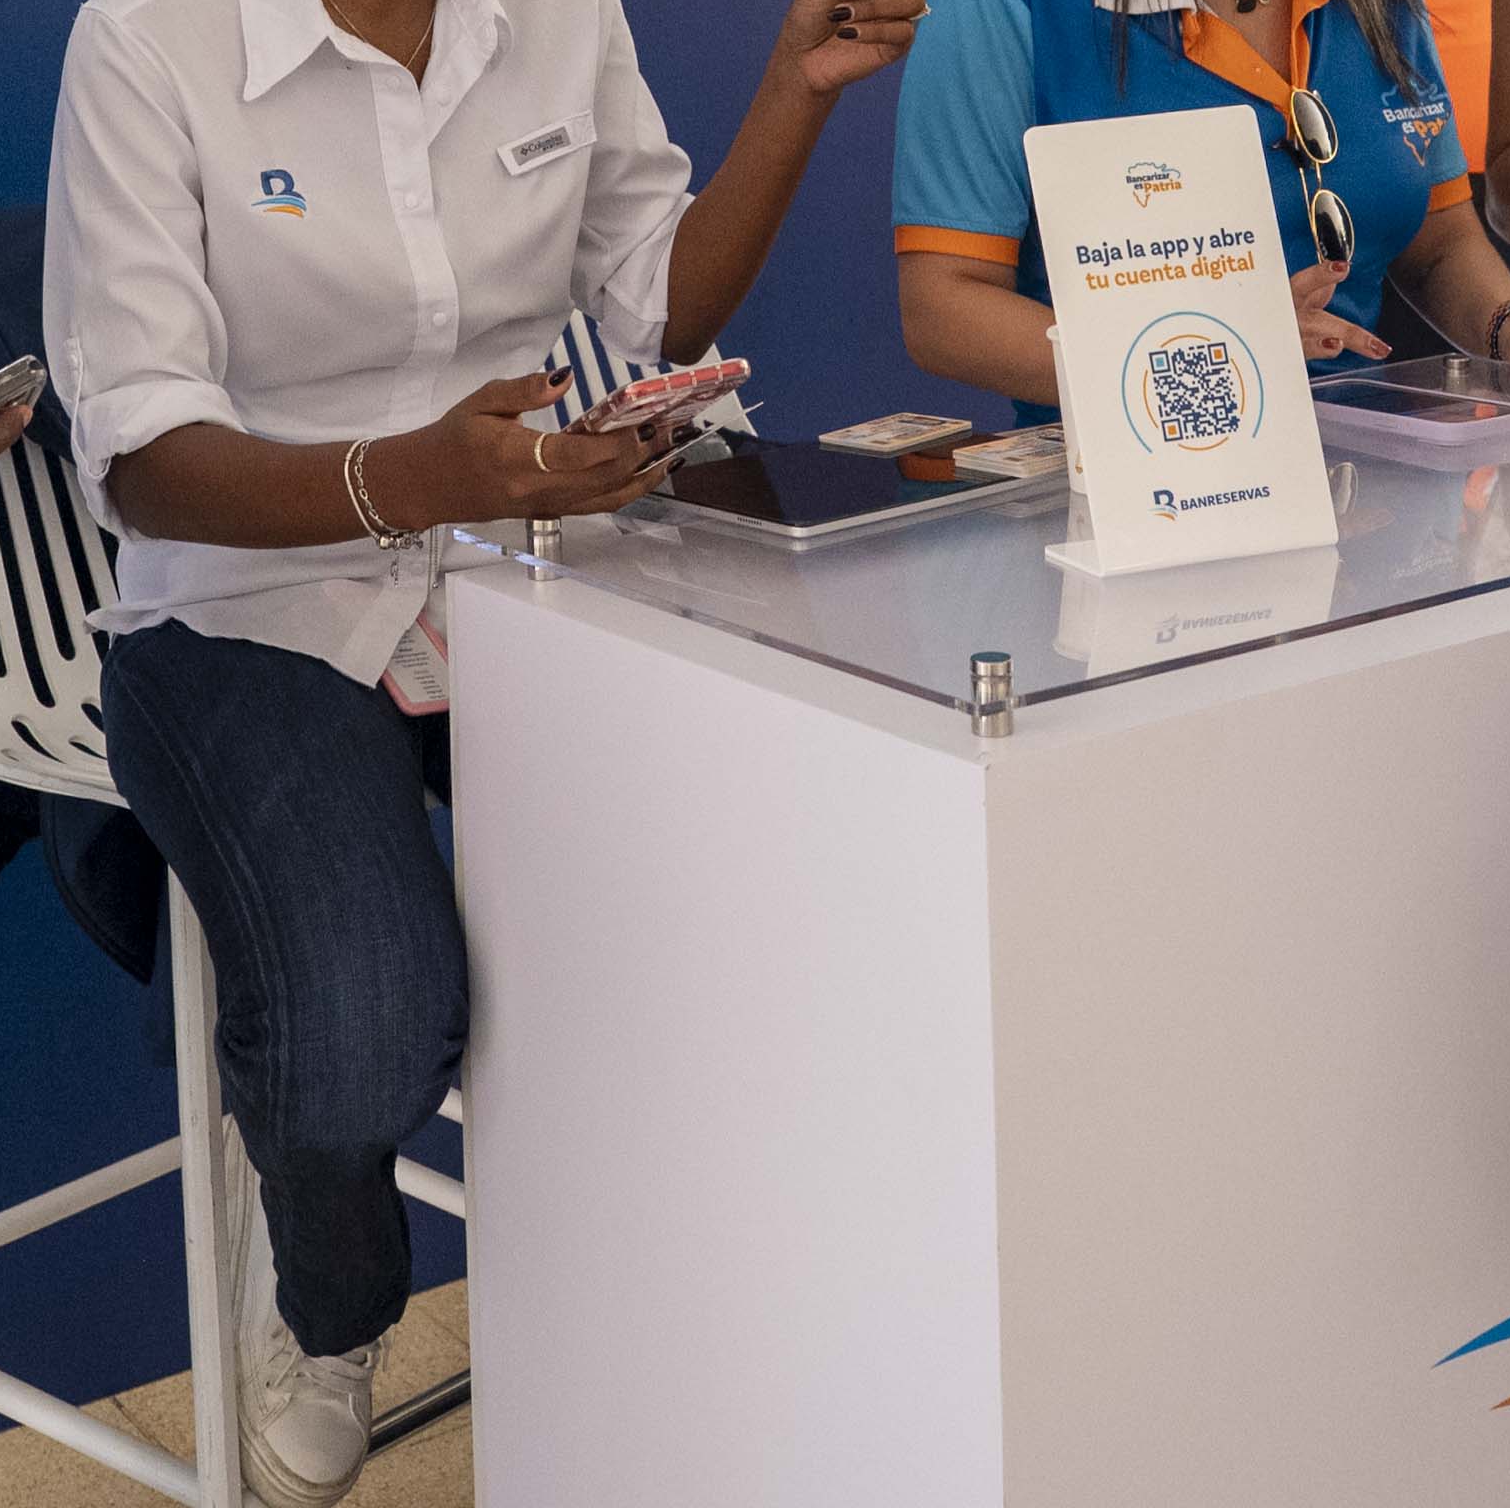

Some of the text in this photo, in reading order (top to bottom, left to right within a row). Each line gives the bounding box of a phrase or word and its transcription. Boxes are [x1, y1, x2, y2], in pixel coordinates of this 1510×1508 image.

[1075, 228, 1256, 267] Baja la app y abre
[1085, 251, 1256, 290] tu cuenta digital
[1180, 486, 1271, 511] BANRESERVAS
